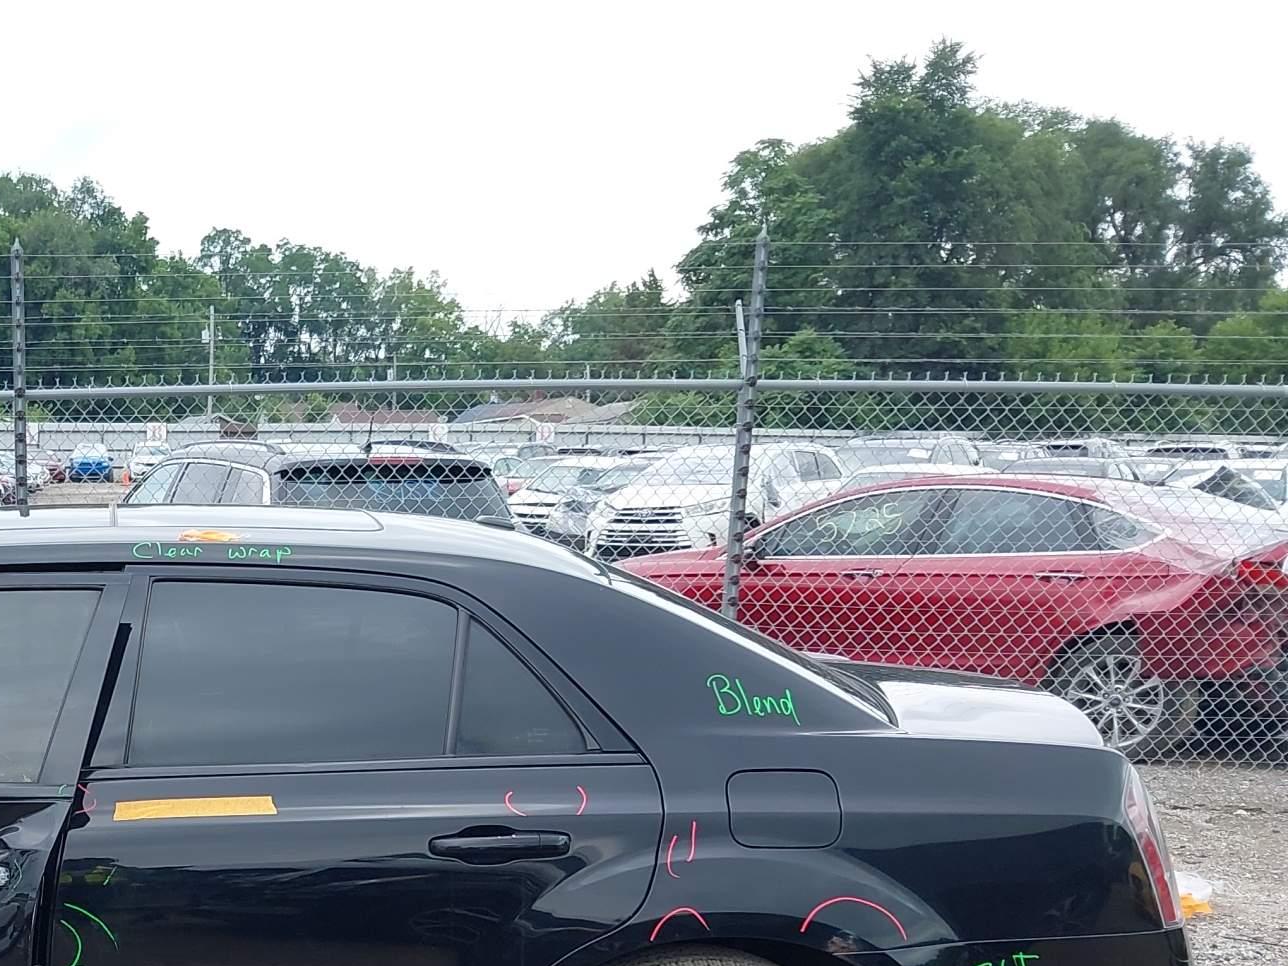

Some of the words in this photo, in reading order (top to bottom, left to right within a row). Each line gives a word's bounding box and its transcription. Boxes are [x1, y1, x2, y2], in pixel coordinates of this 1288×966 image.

[133, 541, 203, 559] Clear
[228, 546, 291, 567] wrap
[706, 673, 801, 726] Blend
